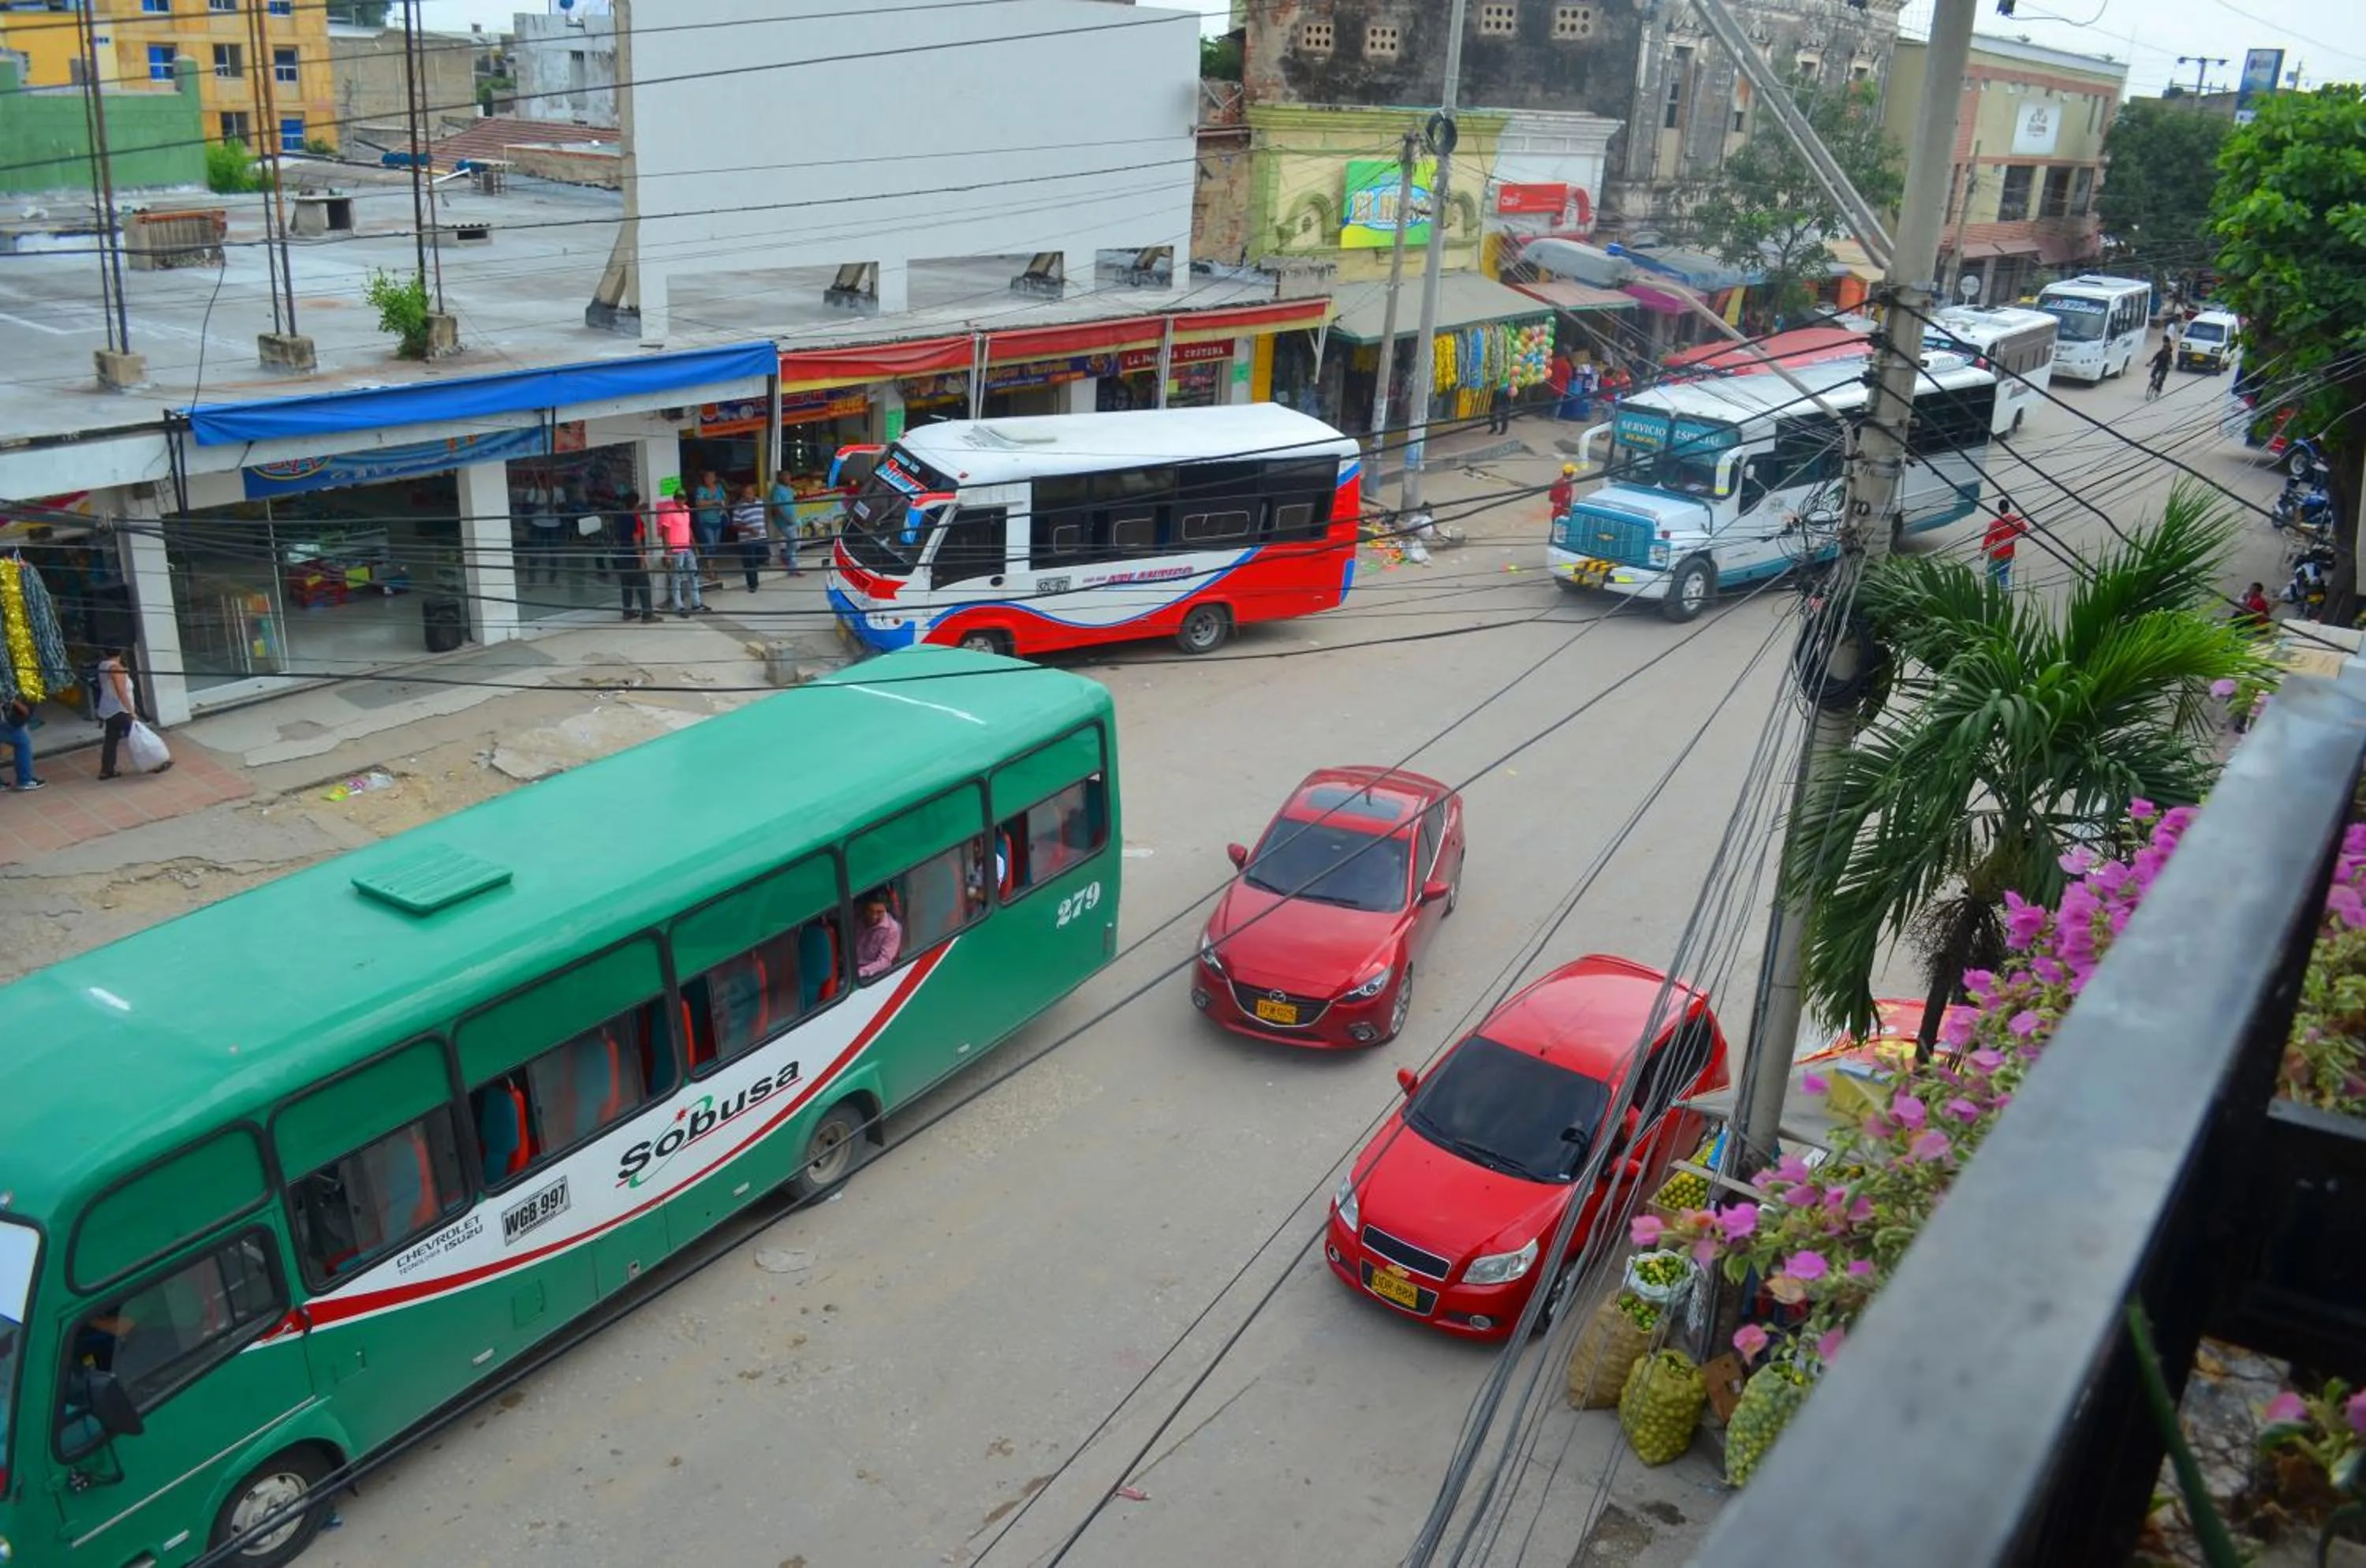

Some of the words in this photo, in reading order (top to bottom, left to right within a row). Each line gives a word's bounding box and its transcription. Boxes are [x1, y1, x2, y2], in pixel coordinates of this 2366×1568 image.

[1621, 420, 1666, 437] SERVICIO
[1056, 881, 1100, 928] 279
[618, 1060, 800, 1179] Sobusa
[397, 1214, 480, 1267] CHEVROLET
[444, 1224, 483, 1253] ISUZU
